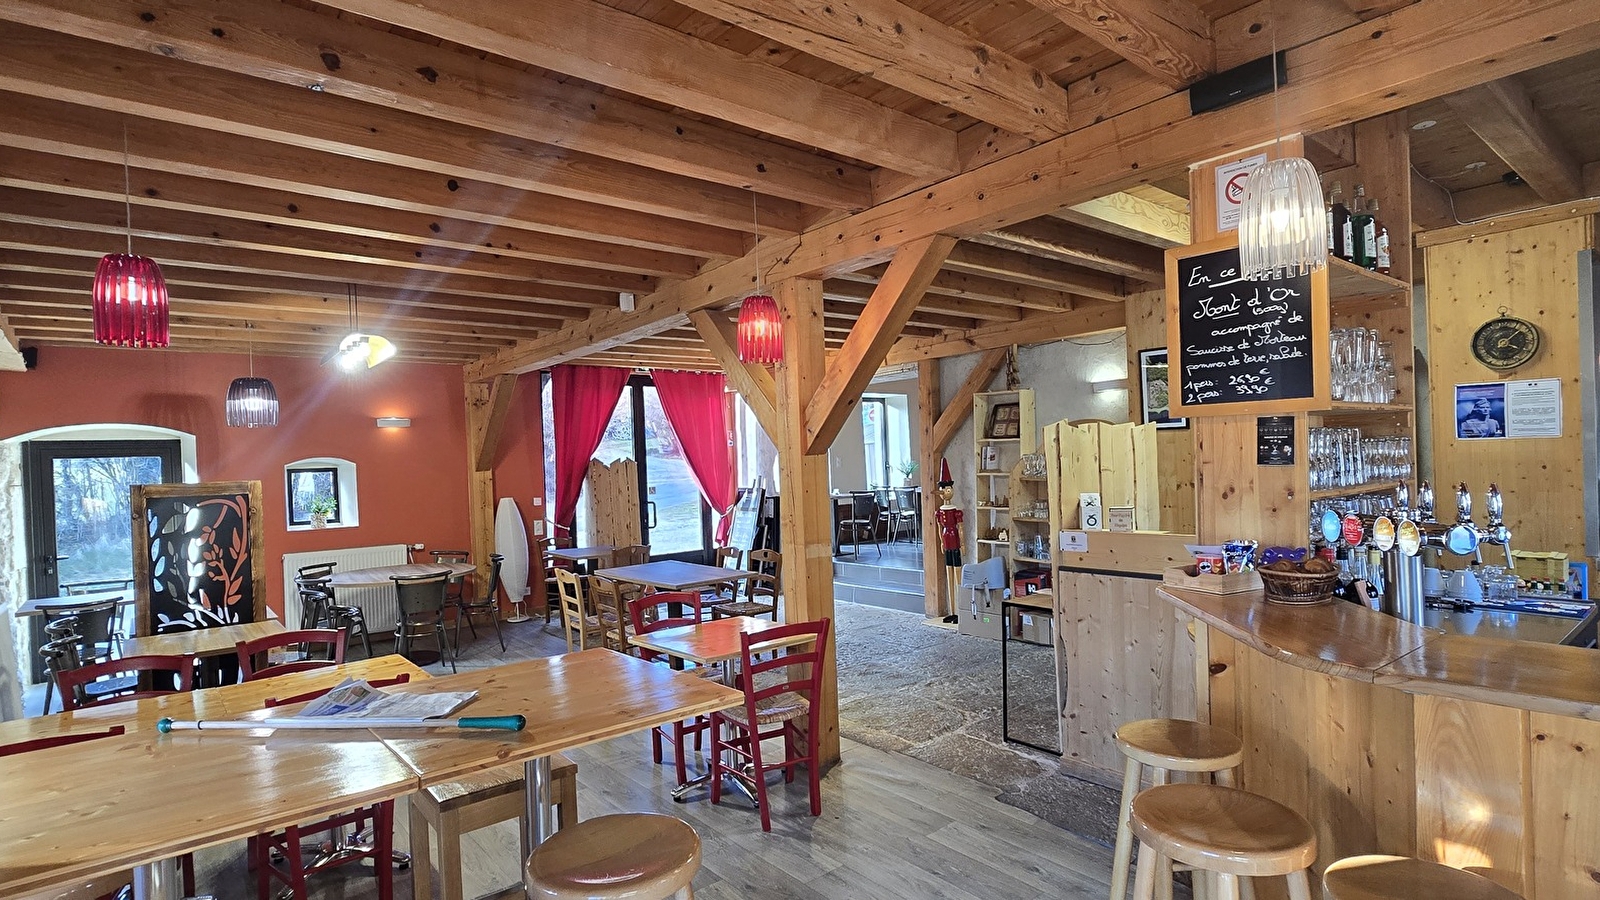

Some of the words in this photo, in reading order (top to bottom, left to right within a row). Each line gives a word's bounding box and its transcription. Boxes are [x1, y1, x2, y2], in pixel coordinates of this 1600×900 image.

[1188, 266, 1211, 287] En
[1220, 268, 1236, 278] ce
[1193, 293, 1240, 318] Mont
[1211, 316, 1282, 336] accompagné
[1288, 311, 1304, 323] de
[1186, 345, 1235, 356] Saucisse
[1237, 339, 1250, 349] de
[1254, 330, 1307, 346] Morteau
[1186, 360, 1226, 376] pommes
[1228, 355, 1240, 366] de
[1186, 394, 1196, 404] 2
